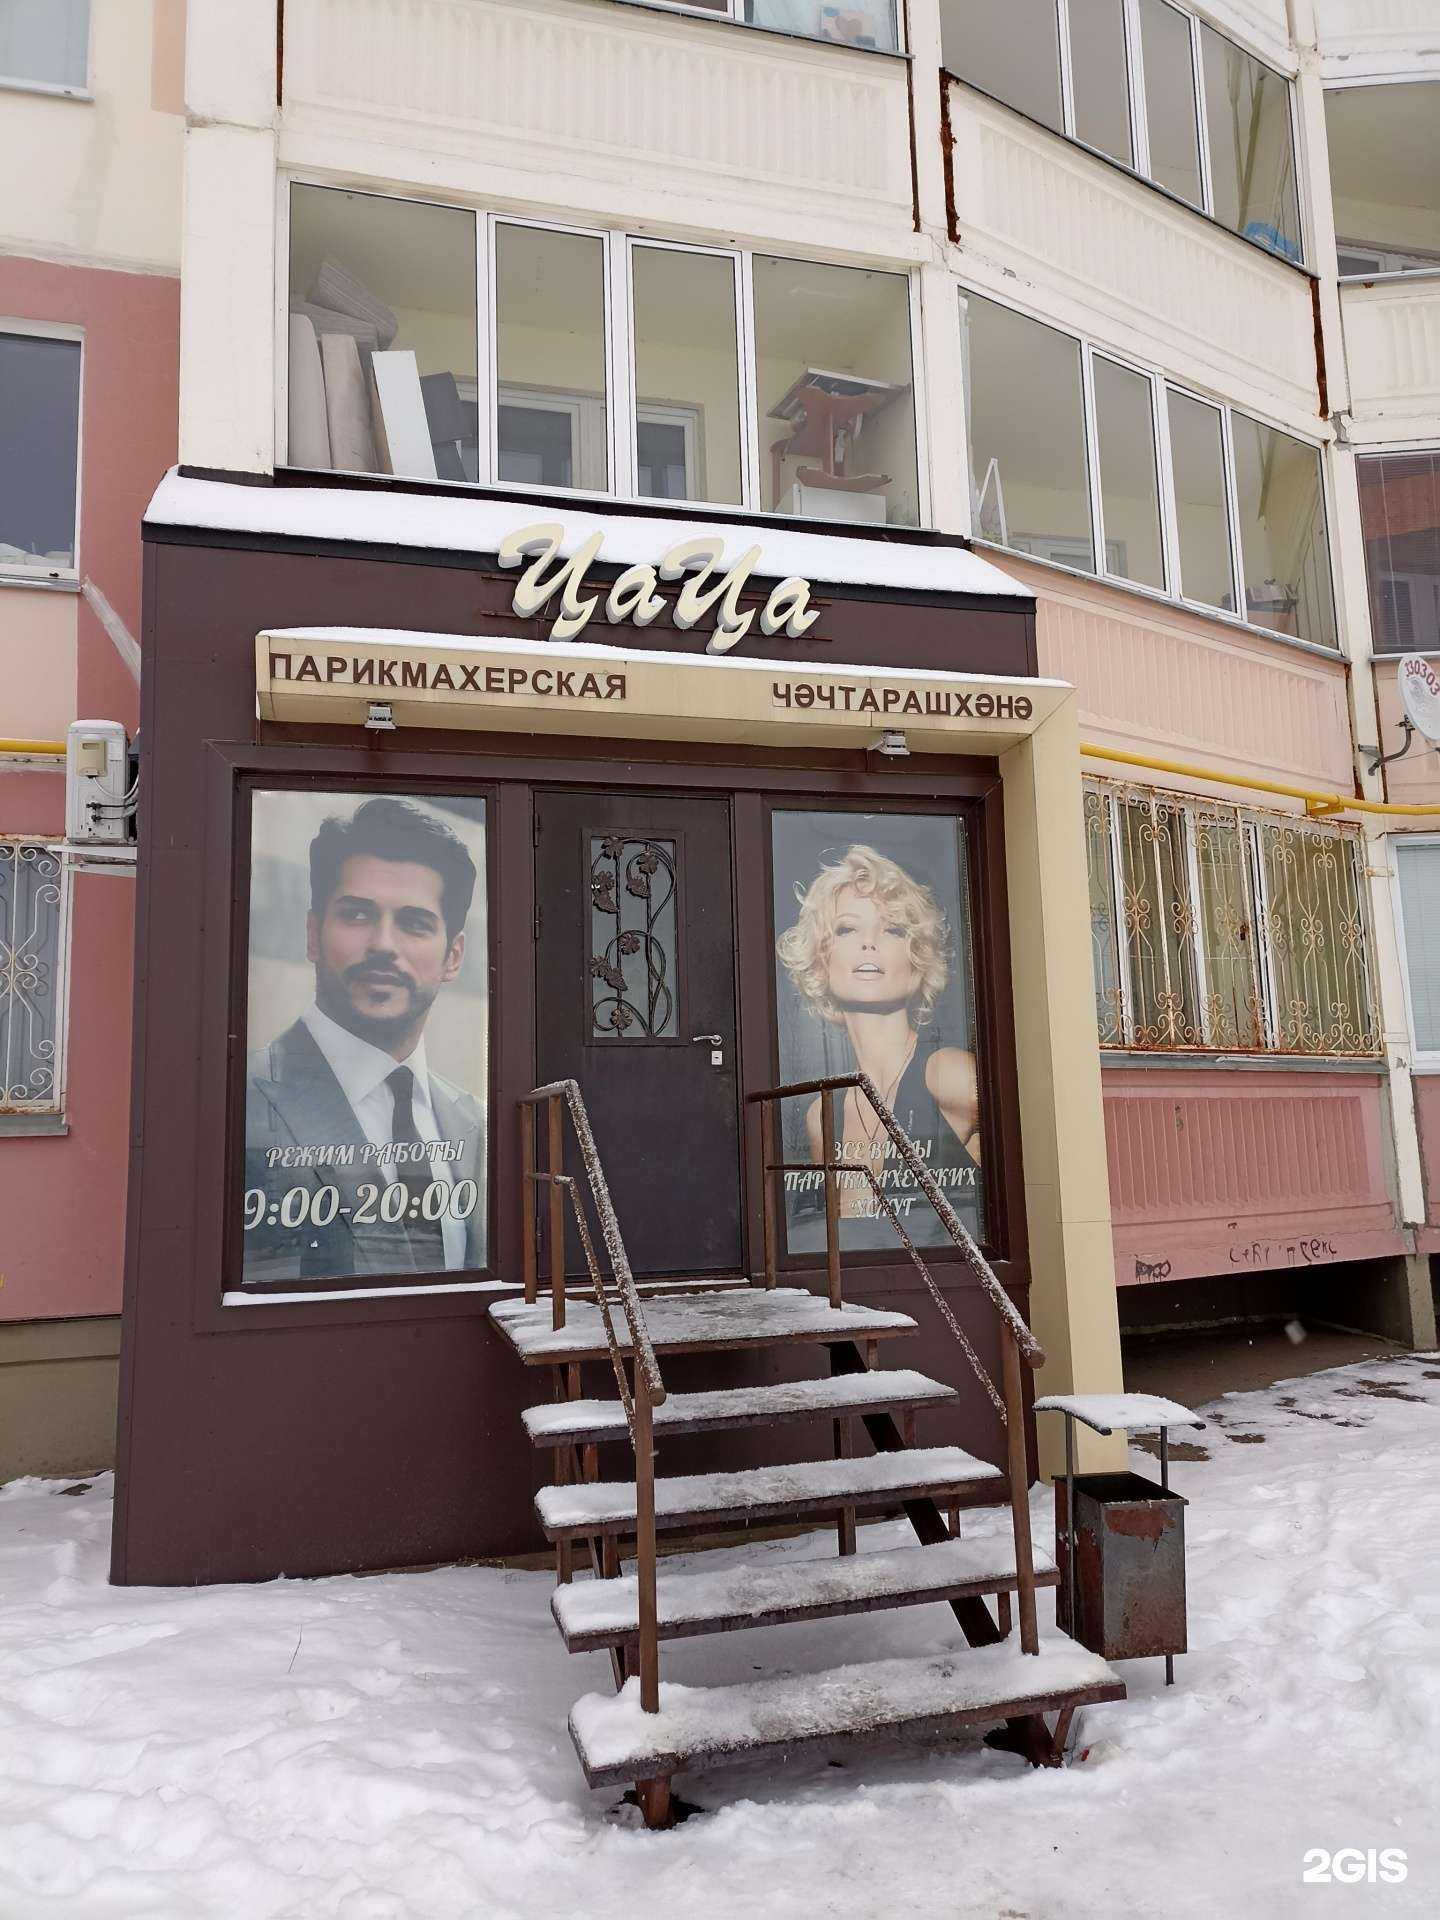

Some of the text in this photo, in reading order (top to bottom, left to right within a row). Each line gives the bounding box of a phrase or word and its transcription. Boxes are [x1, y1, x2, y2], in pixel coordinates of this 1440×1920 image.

[269, 652, 626, 699] ПАРИКМАХЕРСКАЯ
[265, 1140, 465, 1168] РЕЖИМ РАБОТЫ
[868, 1139, 932, 1160] ВИЫ
[244, 1179, 478, 1231] 9:00-20:00
